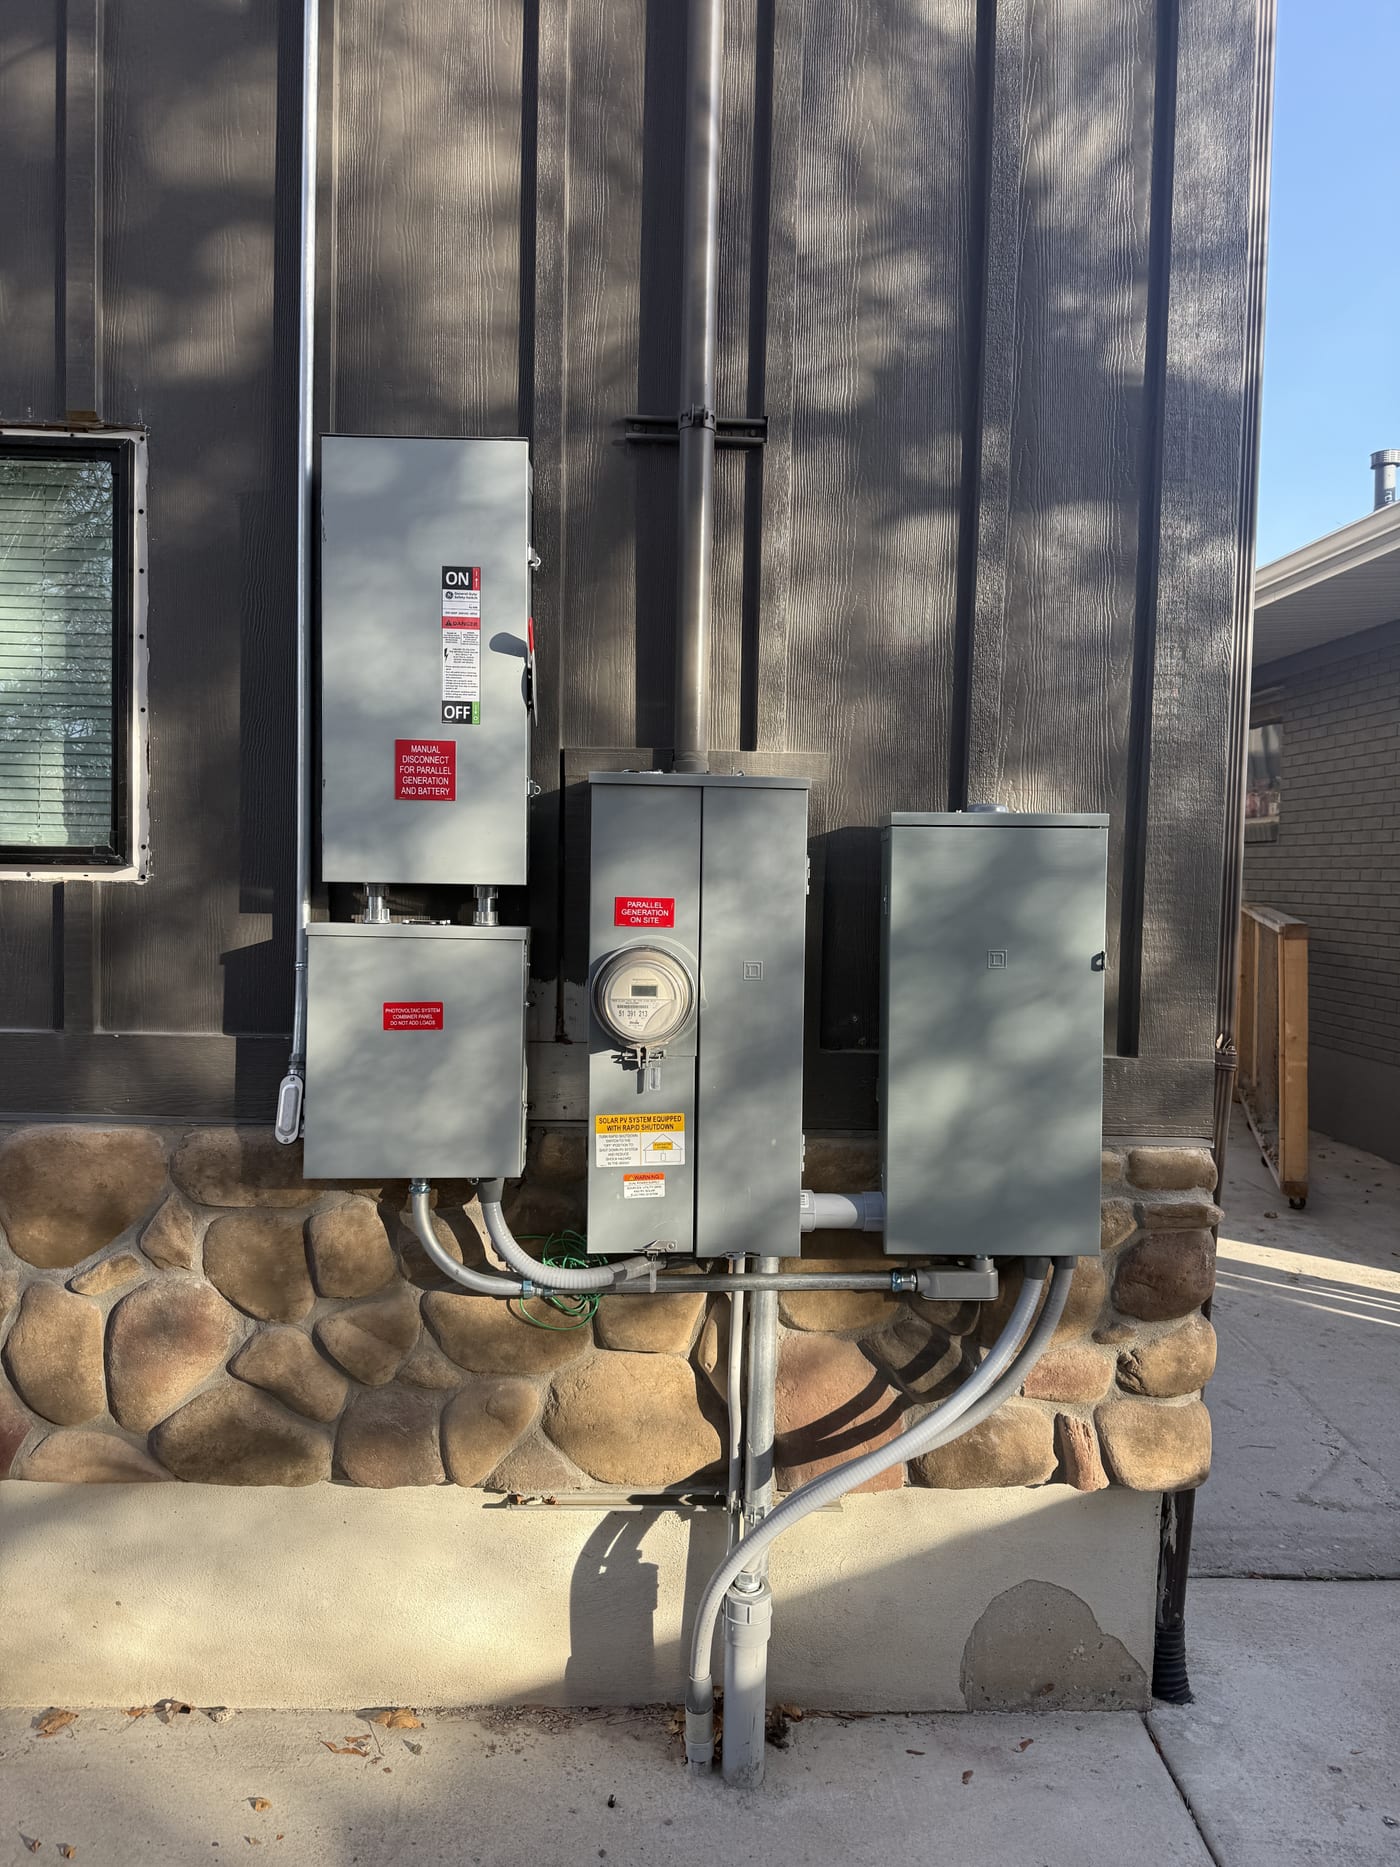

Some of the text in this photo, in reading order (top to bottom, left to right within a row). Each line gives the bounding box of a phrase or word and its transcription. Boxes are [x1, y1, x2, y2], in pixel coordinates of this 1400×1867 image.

[445, 571, 469, 586] ON
[444, 705, 470, 720] OFF
[410, 744, 441, 754] MANUAL
[402, 754, 450, 764] DISCONNECT
[400, 766, 452, 775] FOR PARALLEL
[402, 776, 448, 785] GENERATION
[400, 786, 450, 796] AND BATTERY
[621, 908, 668, 916] GENERATION
